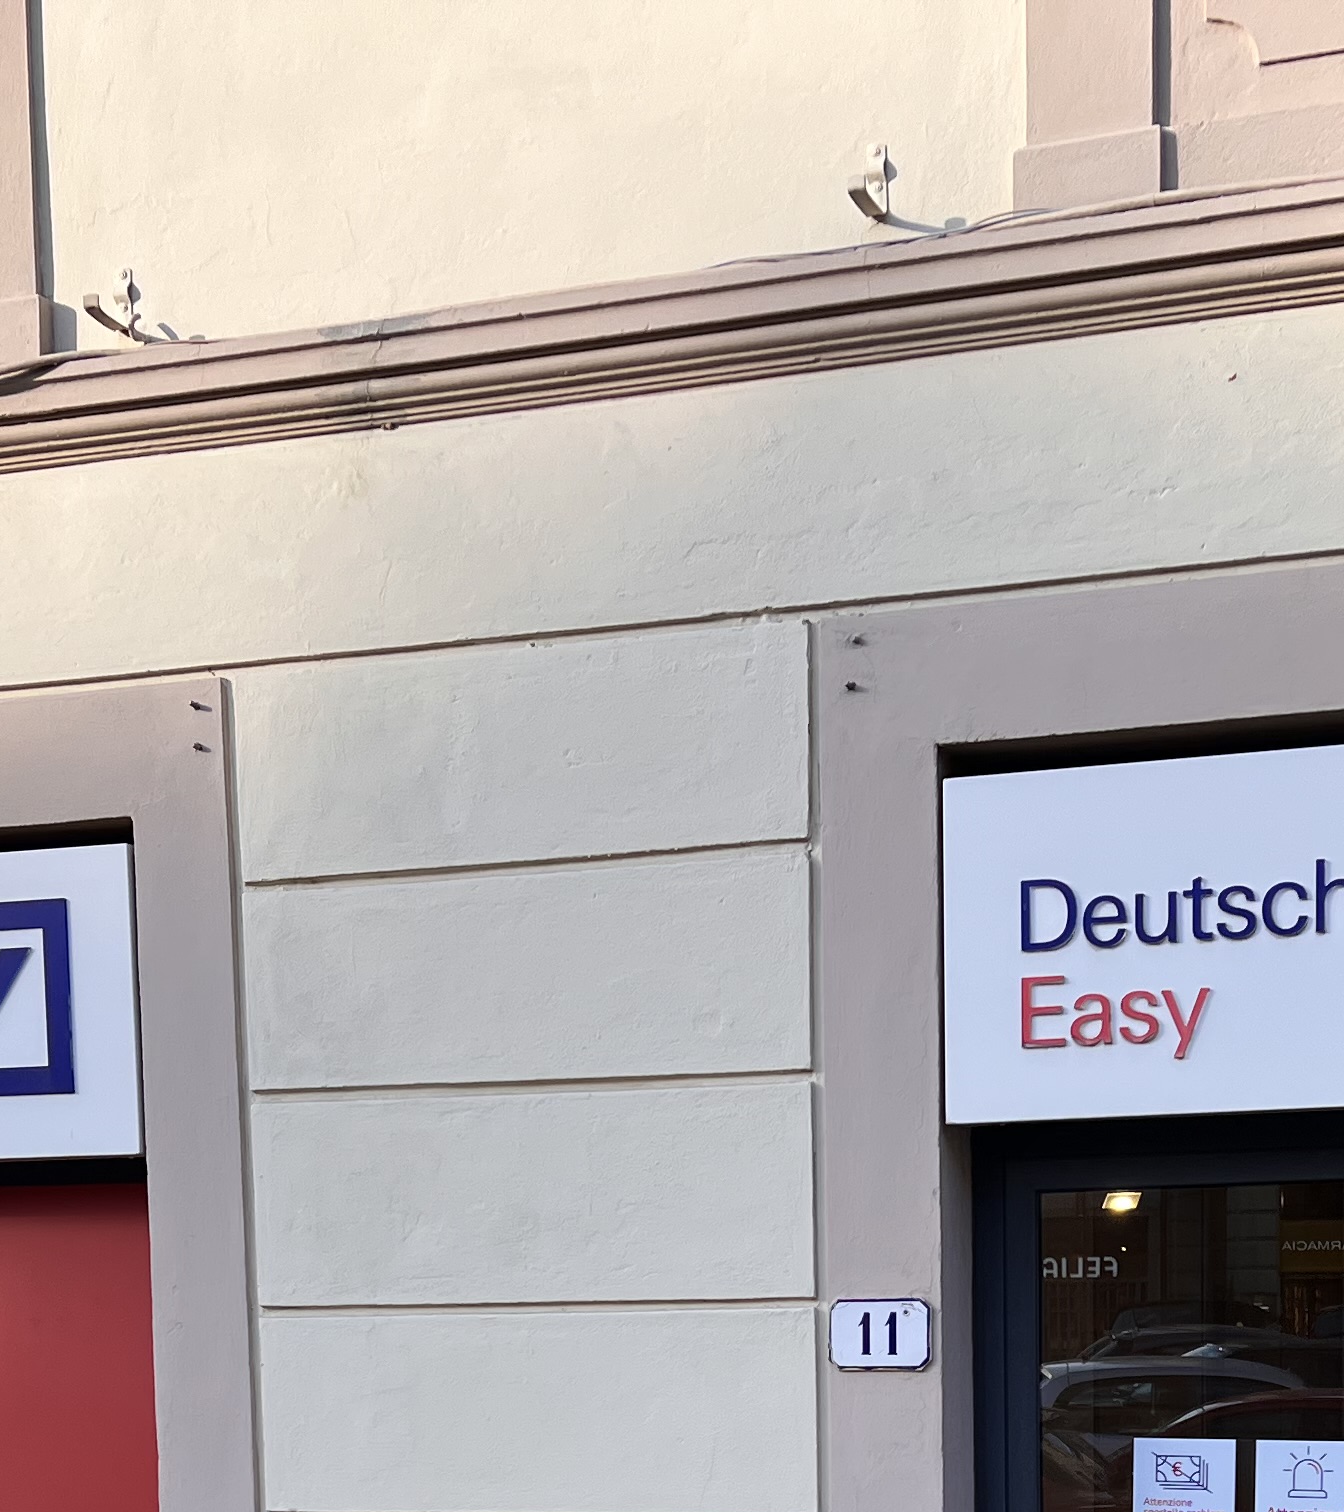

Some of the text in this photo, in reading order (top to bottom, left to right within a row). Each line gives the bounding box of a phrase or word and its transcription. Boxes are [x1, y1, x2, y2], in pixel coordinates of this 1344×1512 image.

[1020, 974, 1211, 1060] Easy
[858, 1311, 898, 1356] 11
[1143, 1496, 1193, 1507] Attenzione
